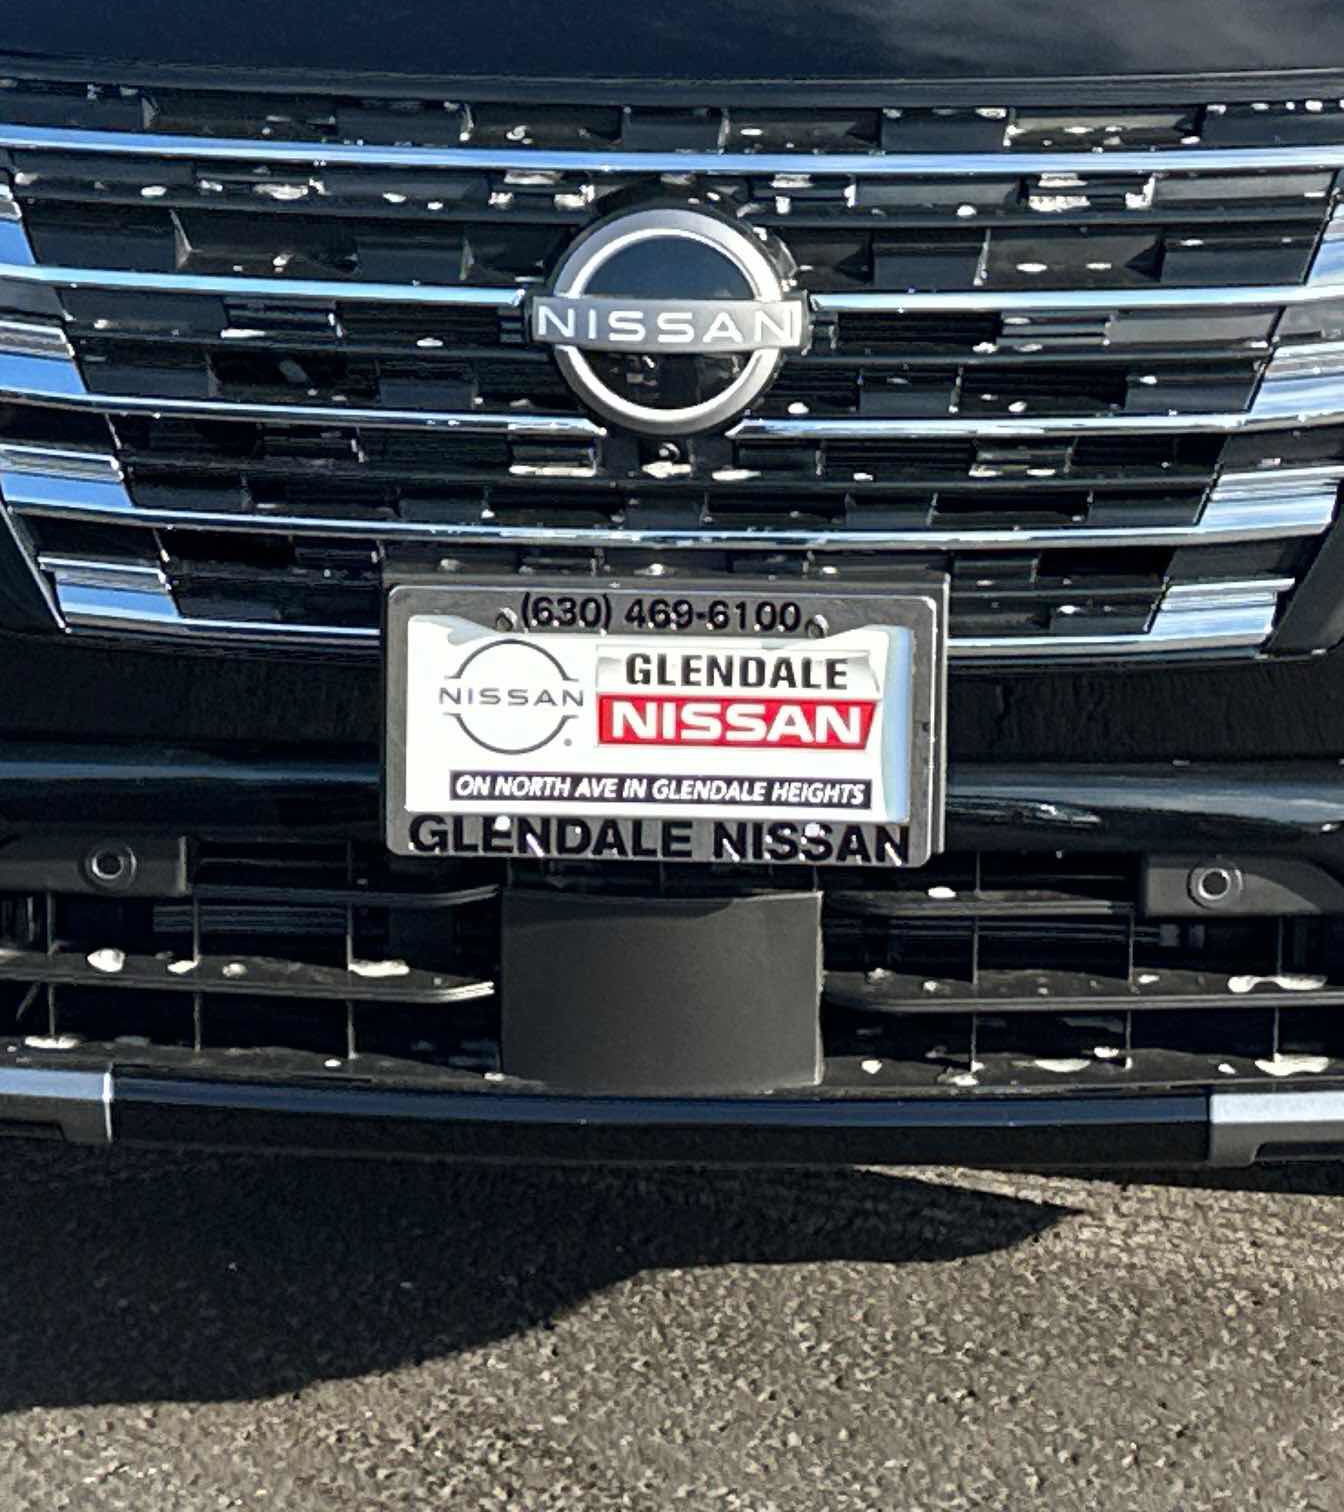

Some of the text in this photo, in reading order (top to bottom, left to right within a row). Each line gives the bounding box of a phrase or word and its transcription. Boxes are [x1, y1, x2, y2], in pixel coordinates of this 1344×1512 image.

[537, 303, 793, 344] NISSAN
[521, 592, 802, 634] (630) 469-6100
[625, 652, 849, 690] GLENDALE
[439, 686, 584, 707] NISSAN
[611, 700, 862, 744] NISSAN
[456, 774, 866, 805] ON NORTH AVE IN GLENDALE HEIGHTS
[408, 816, 910, 864] GLENDALE NISSAN
